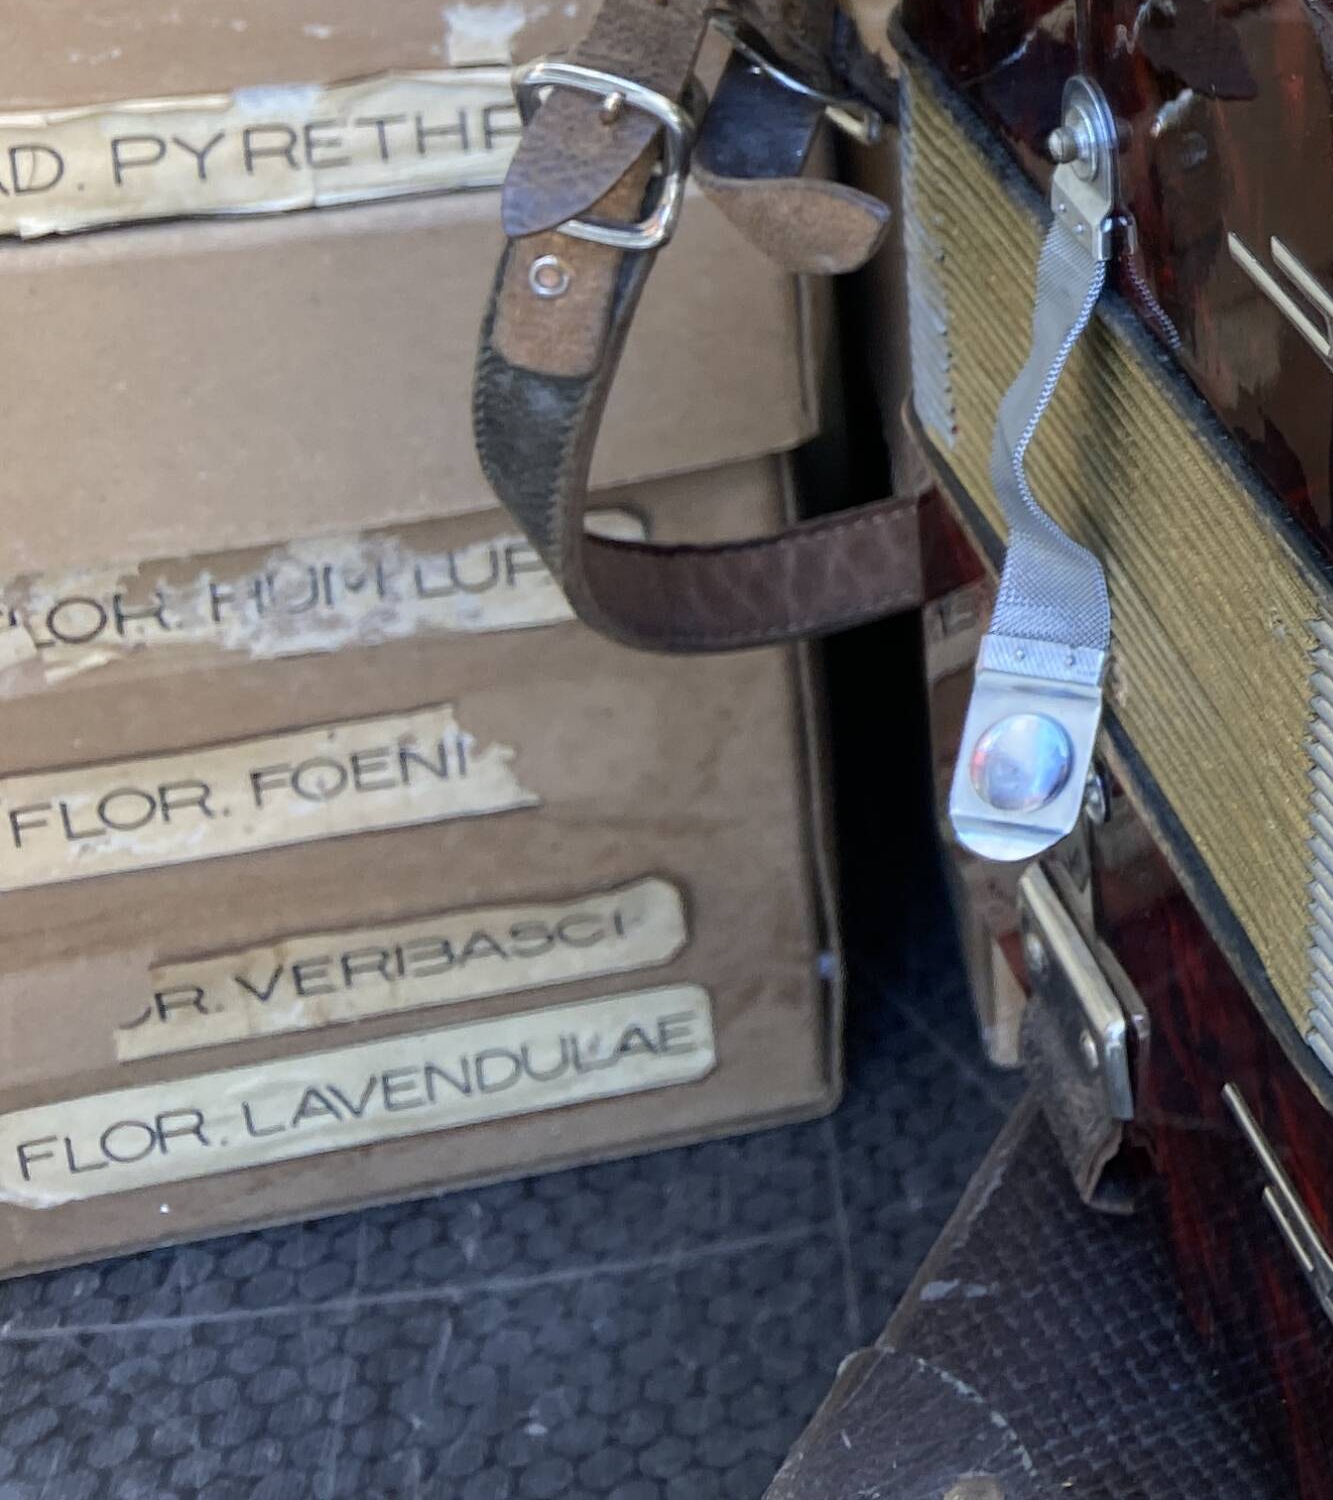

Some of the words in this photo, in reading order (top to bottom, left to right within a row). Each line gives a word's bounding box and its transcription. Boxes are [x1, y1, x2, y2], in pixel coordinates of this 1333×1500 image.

[8, 778, 231, 849] FLOR.
[16, 1107, 229, 1183] FLOR.
[241, 1008, 699, 1140] LAVENDULAE
